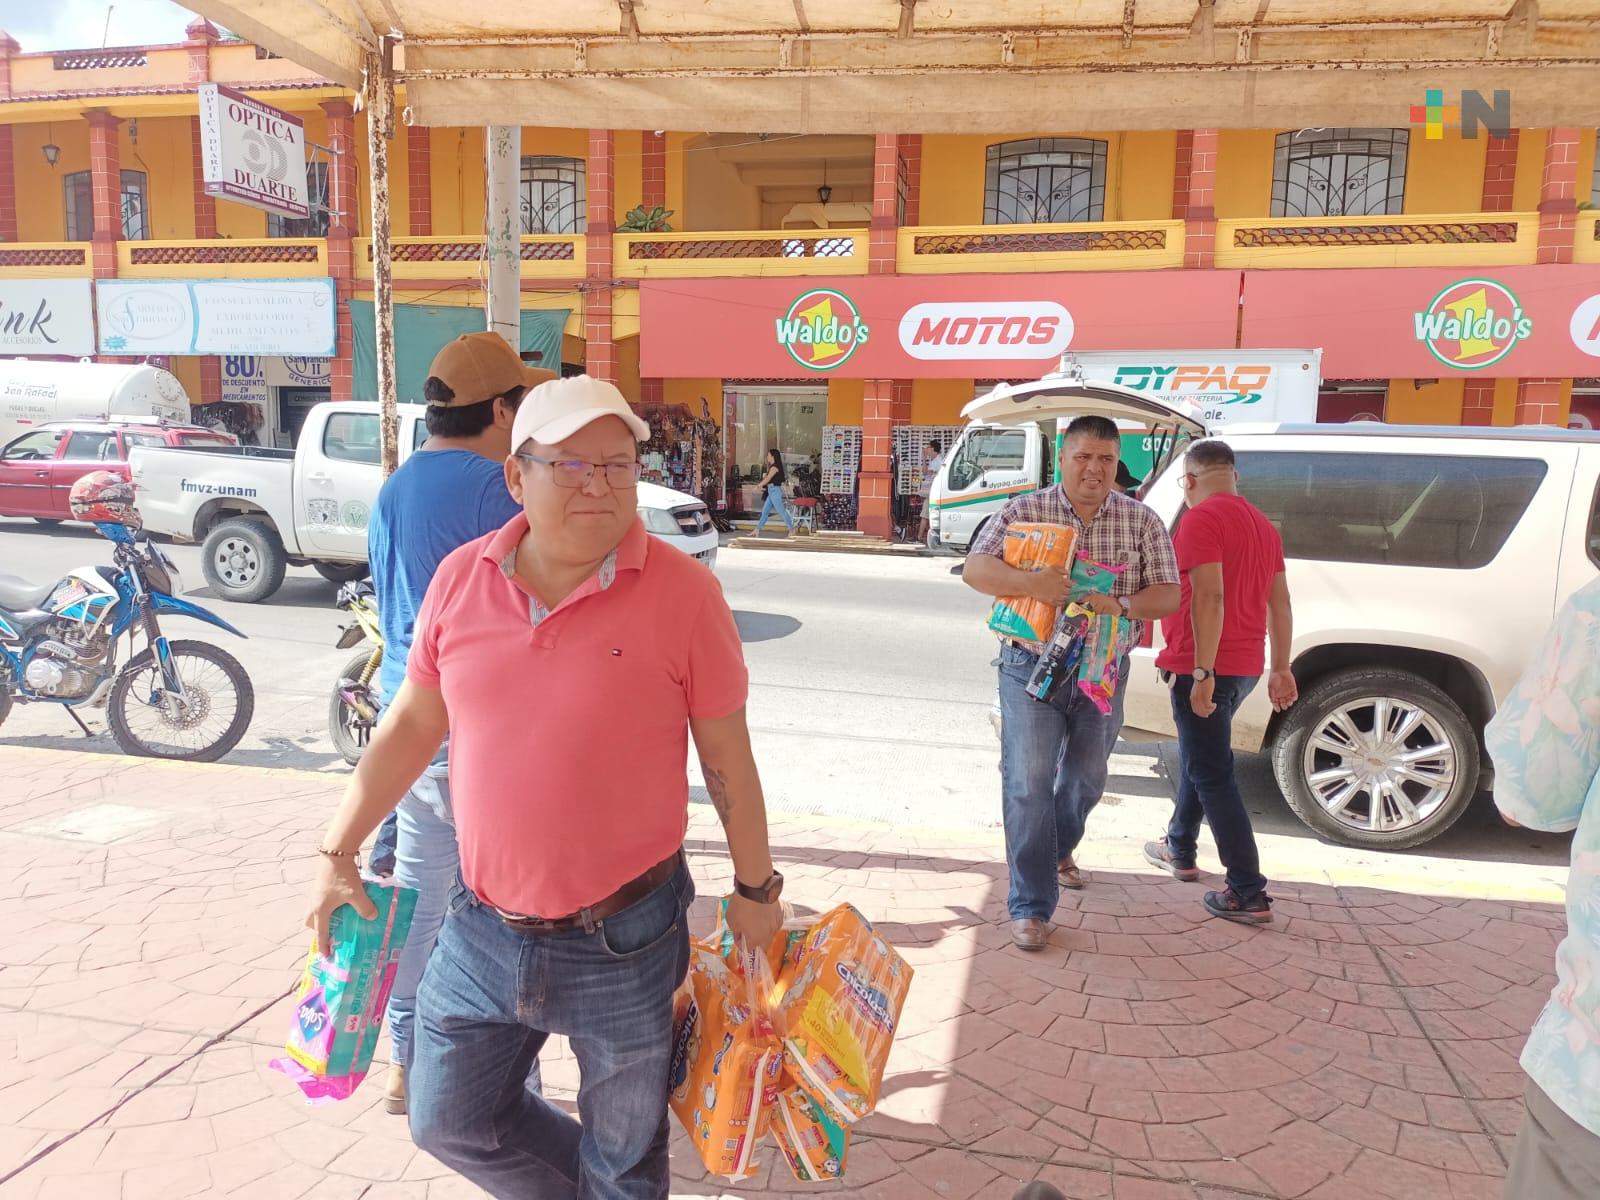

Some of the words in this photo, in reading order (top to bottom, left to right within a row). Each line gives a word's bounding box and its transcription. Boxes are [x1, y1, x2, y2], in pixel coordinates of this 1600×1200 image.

[228, 103, 295, 144] OPTICA
[233, 168, 298, 202] DUARTE
[775, 314, 869, 346] Waldo's
[912, 316, 1060, 345] MOTOS
[1413, 307, 1533, 342] Waldo's
[230, 379, 266, 387] DESCUENTO
[1113, 364, 1272, 396] DYPAQ
[223, 393, 267, 401] MEDICAMENTOS
[180, 478, 257, 498] fmvz-unam
